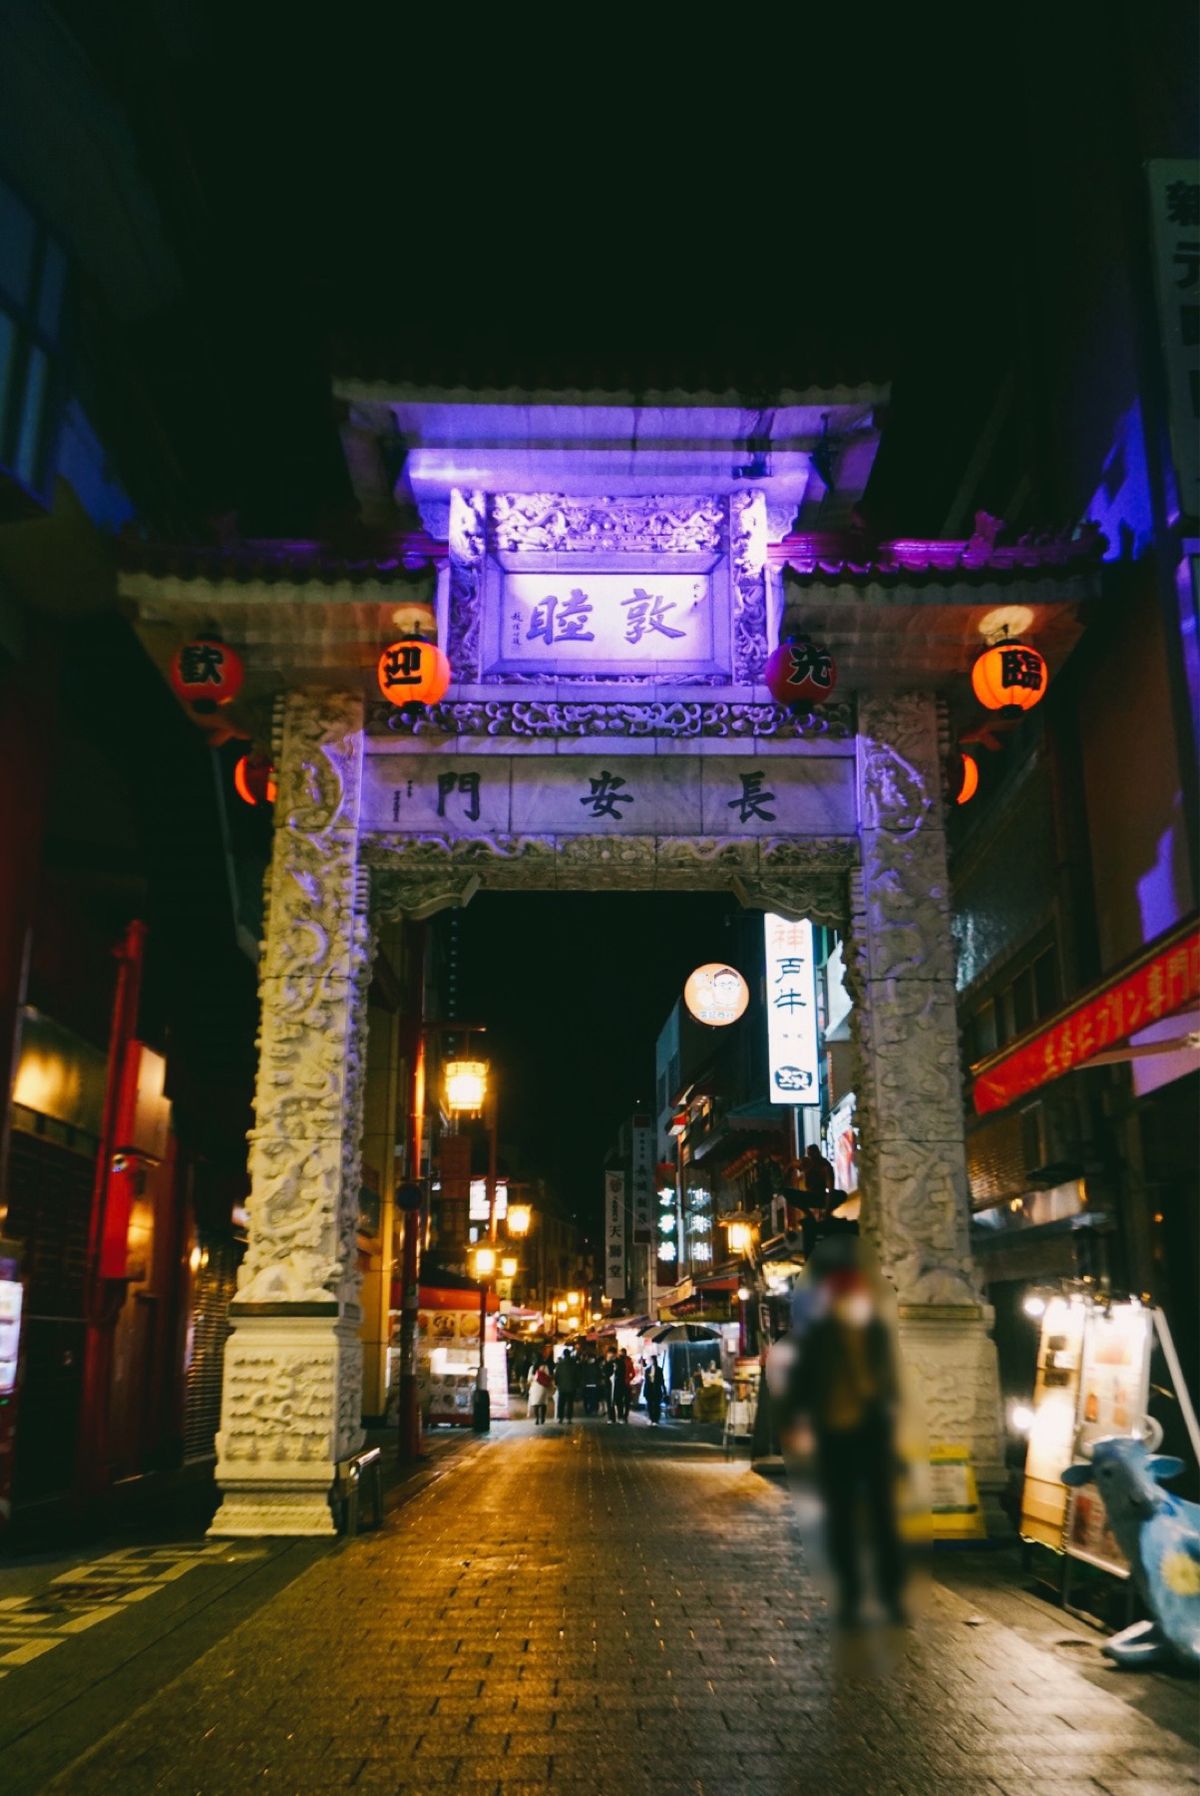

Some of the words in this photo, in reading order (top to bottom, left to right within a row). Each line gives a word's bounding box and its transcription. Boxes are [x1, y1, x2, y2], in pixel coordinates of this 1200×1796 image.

[383, 646, 422, 688] 迎
[786, 646, 832, 687] 光
[437, 770, 777, 823] 長安門
[773, 924, 807, 1015] 神戸牛
